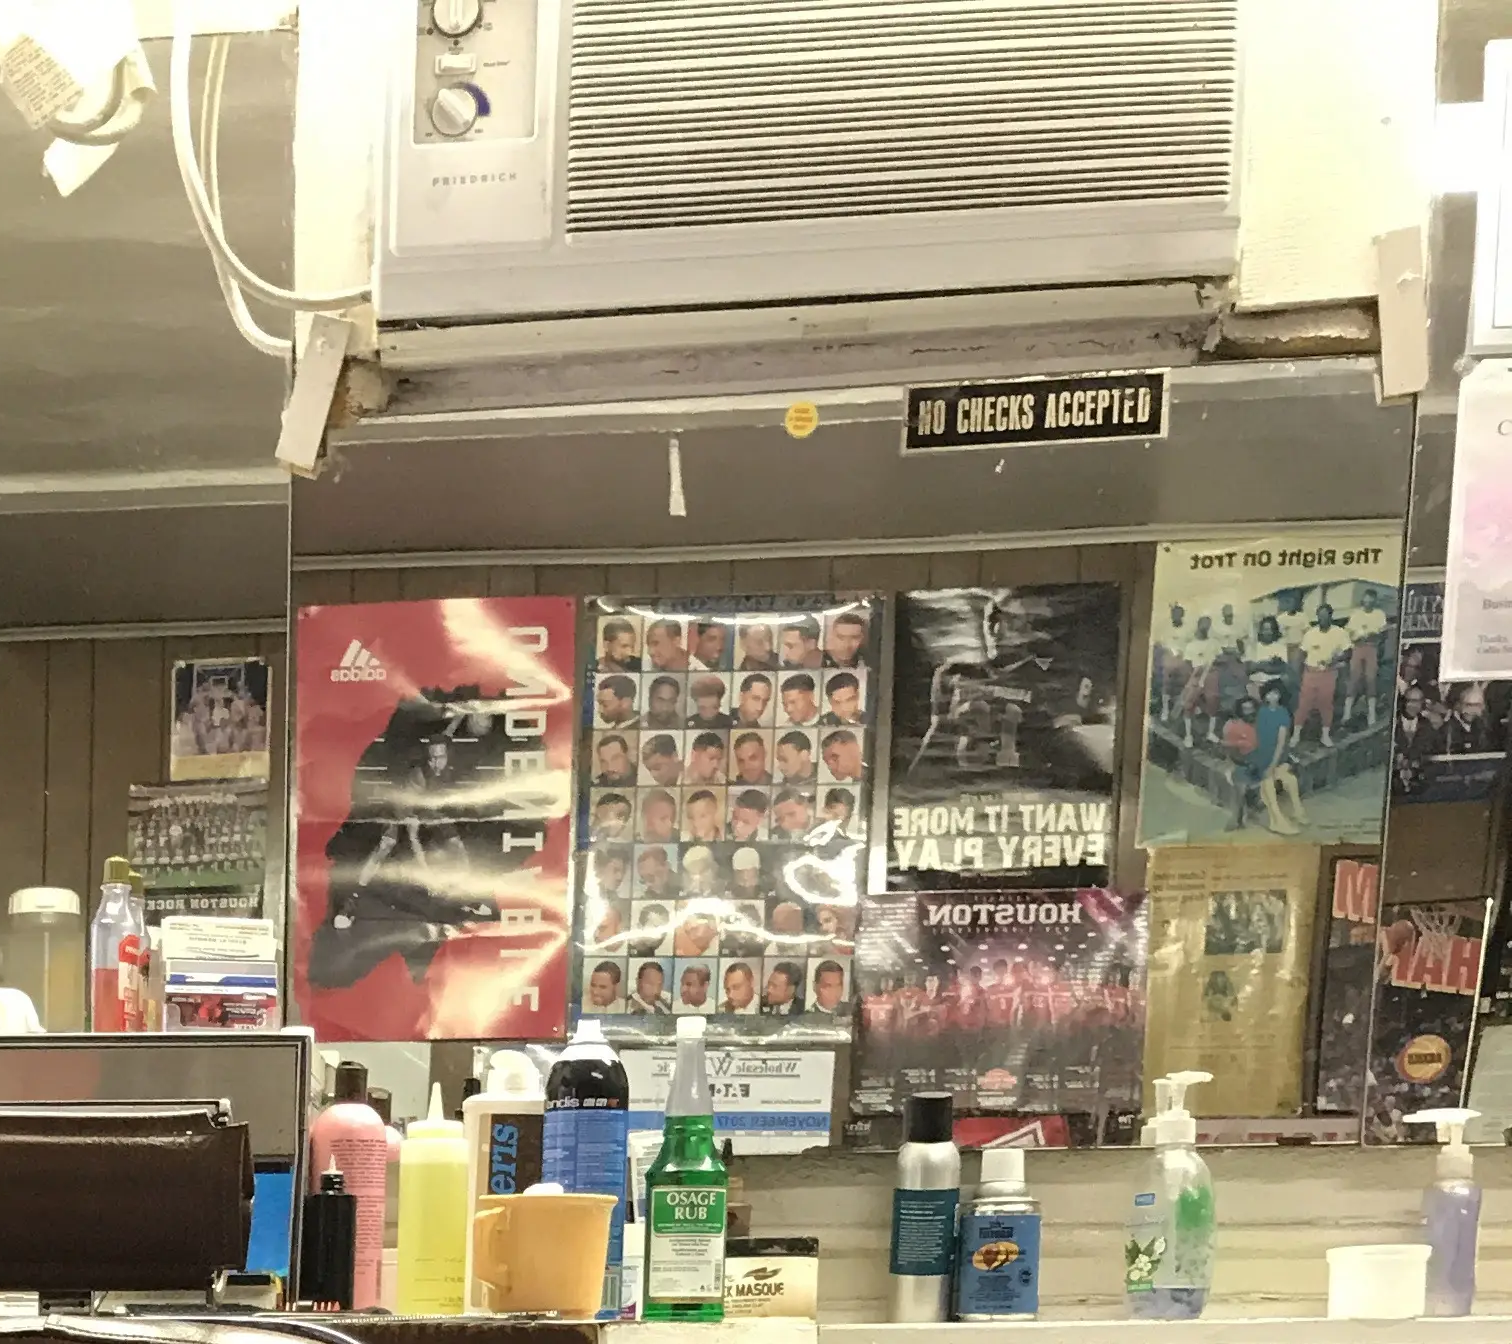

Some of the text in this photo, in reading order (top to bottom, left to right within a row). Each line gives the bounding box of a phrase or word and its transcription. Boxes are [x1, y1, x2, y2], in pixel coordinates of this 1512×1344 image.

[432, 172, 517, 187] FRIEDRICH
[918, 386, 1151, 436] NO CHECKS ACCEPTED
[666, 1191, 717, 1207] OSAGE
[674, 1207, 708, 1221] RUB
[736, 1282, 785, 1297] MASQUE
